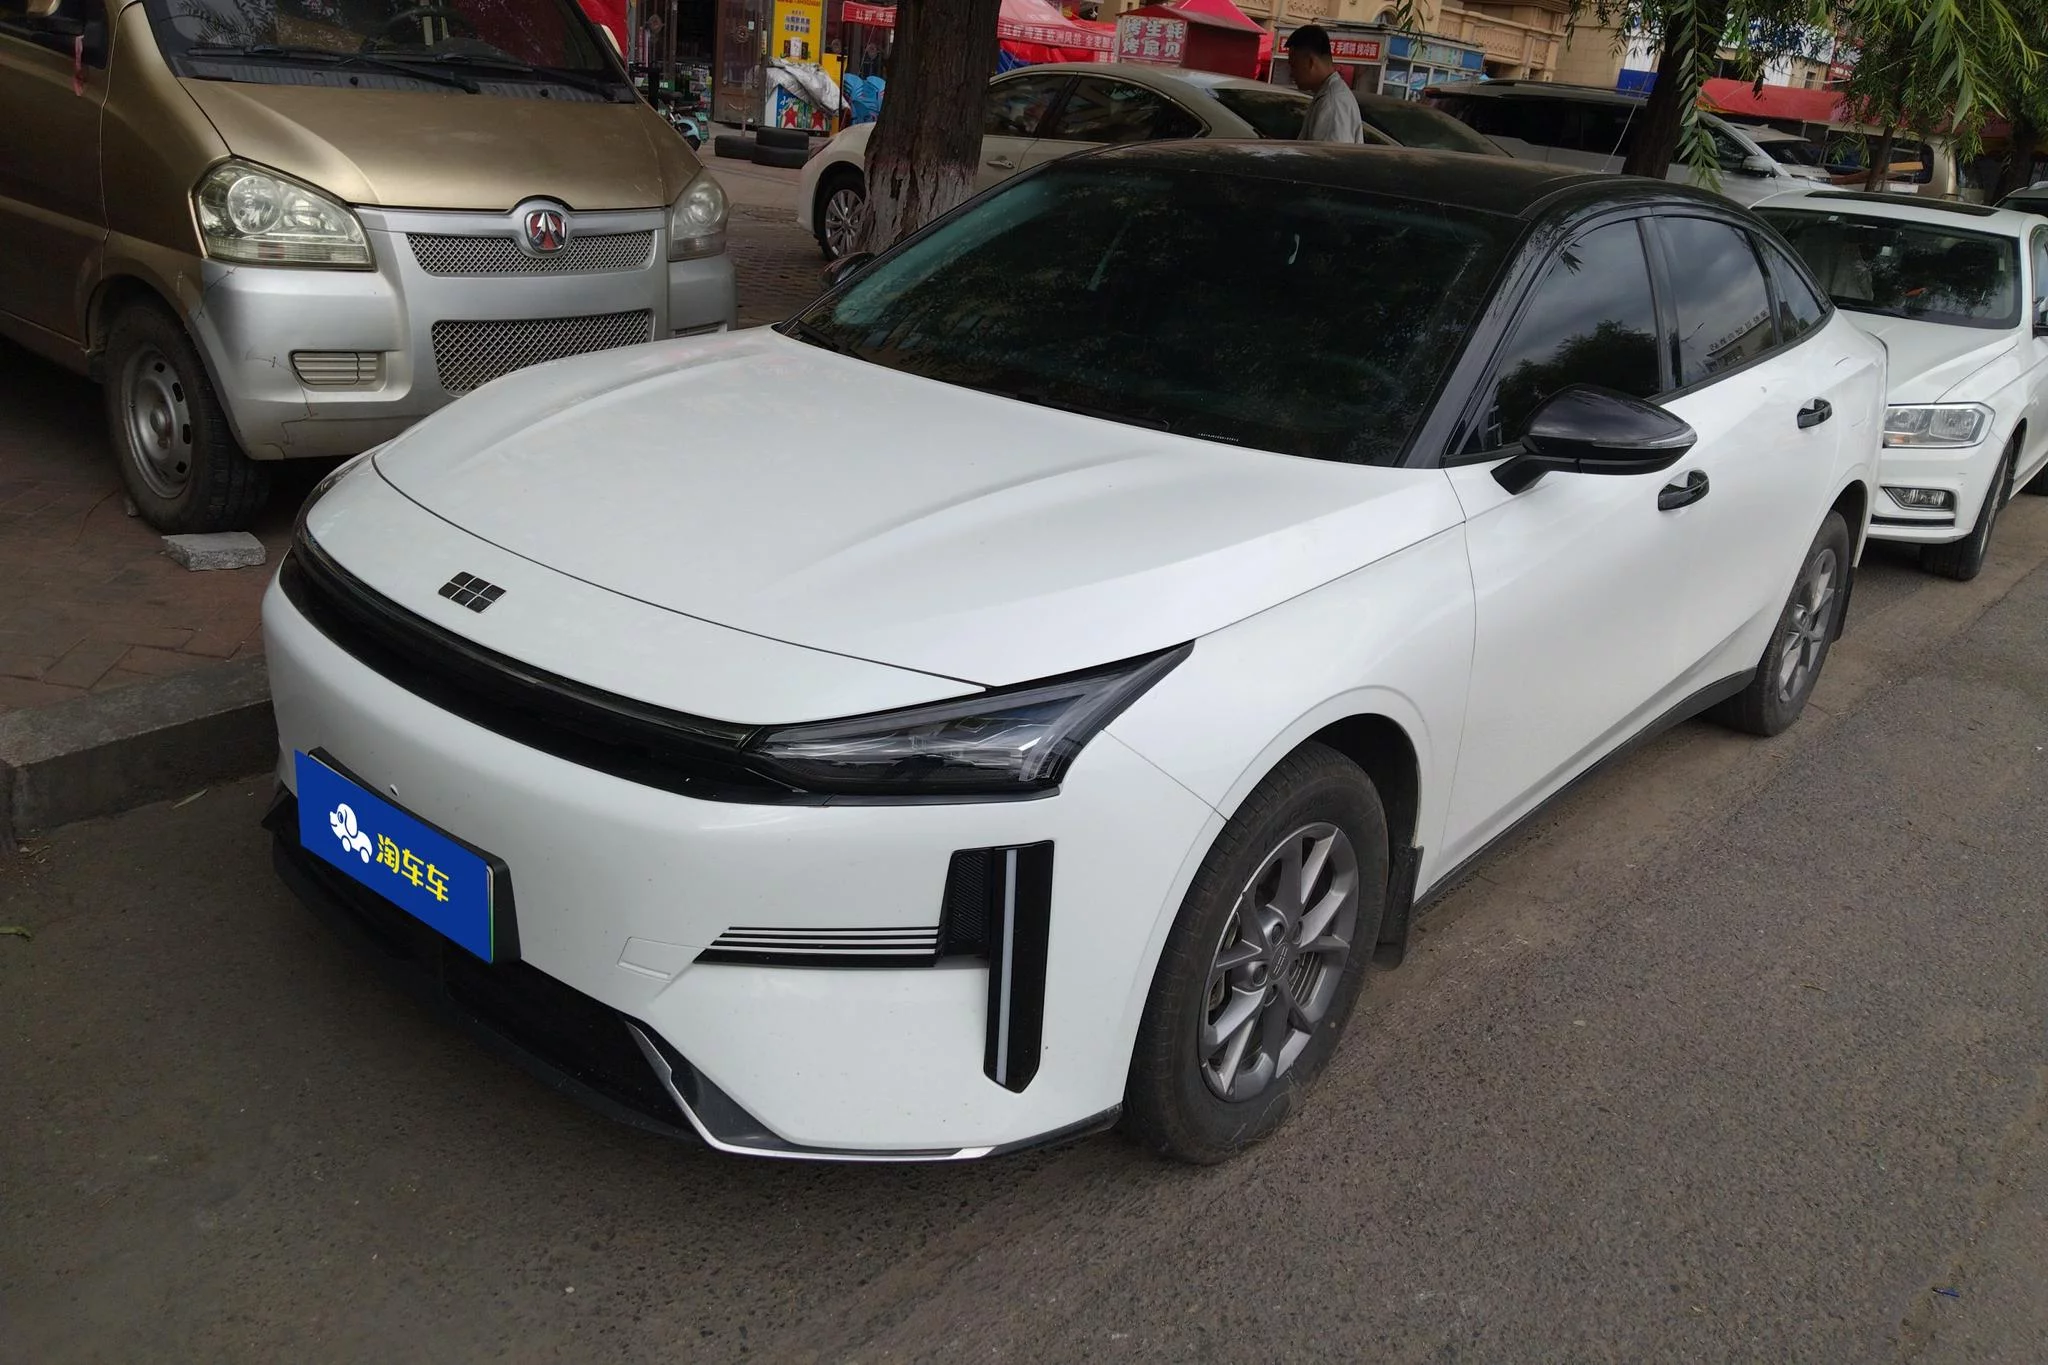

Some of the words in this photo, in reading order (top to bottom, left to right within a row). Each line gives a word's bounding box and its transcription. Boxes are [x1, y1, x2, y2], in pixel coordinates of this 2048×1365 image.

[1126, 18, 1184, 39] 烤生蚝
[1122, 37, 1181, 57] 烤扇贝
